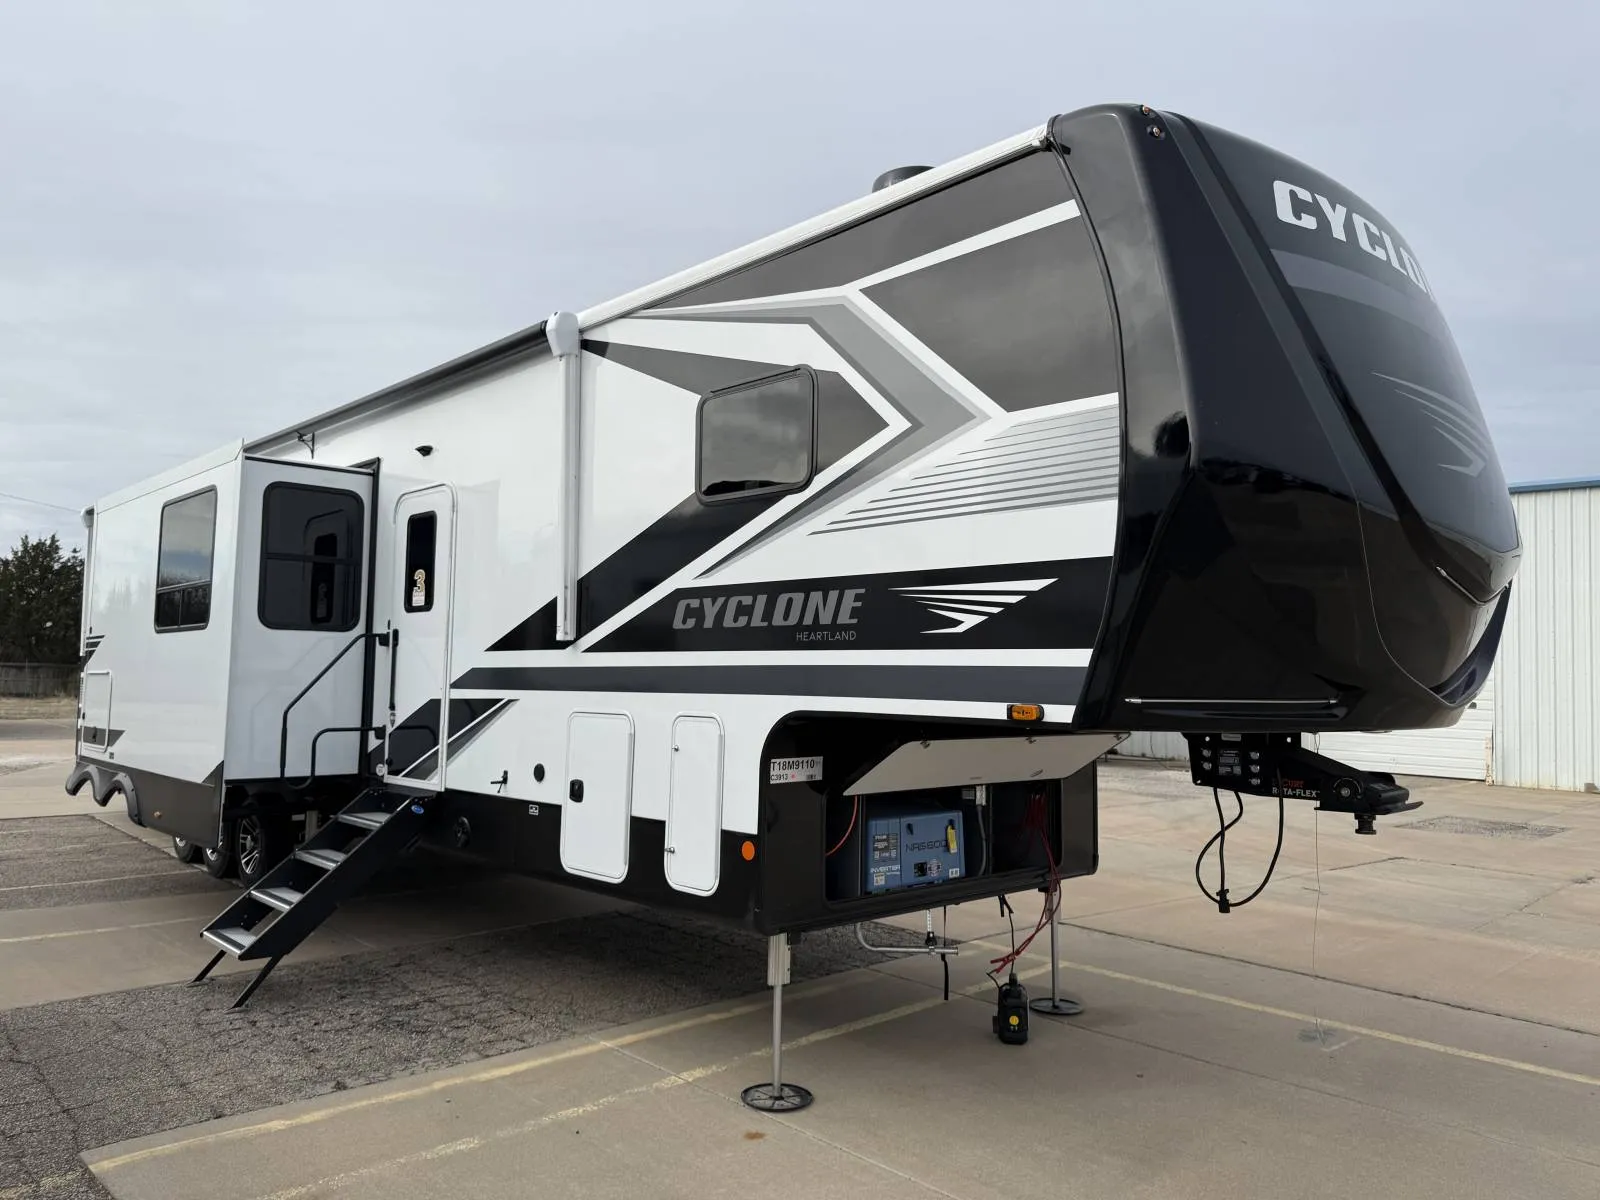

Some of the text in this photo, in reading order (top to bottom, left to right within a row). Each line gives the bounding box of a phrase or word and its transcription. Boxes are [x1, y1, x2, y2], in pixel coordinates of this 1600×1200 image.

[1273, 180, 1437, 303] CYCLO
[414, 569, 426, 593] 3
[672, 588, 866, 630] CYCLONE
[796, 630, 858, 642] HEARTLAND
[771, 759, 815, 771] T18M9110
[1271, 786, 1317, 798] RTA-FLEX
